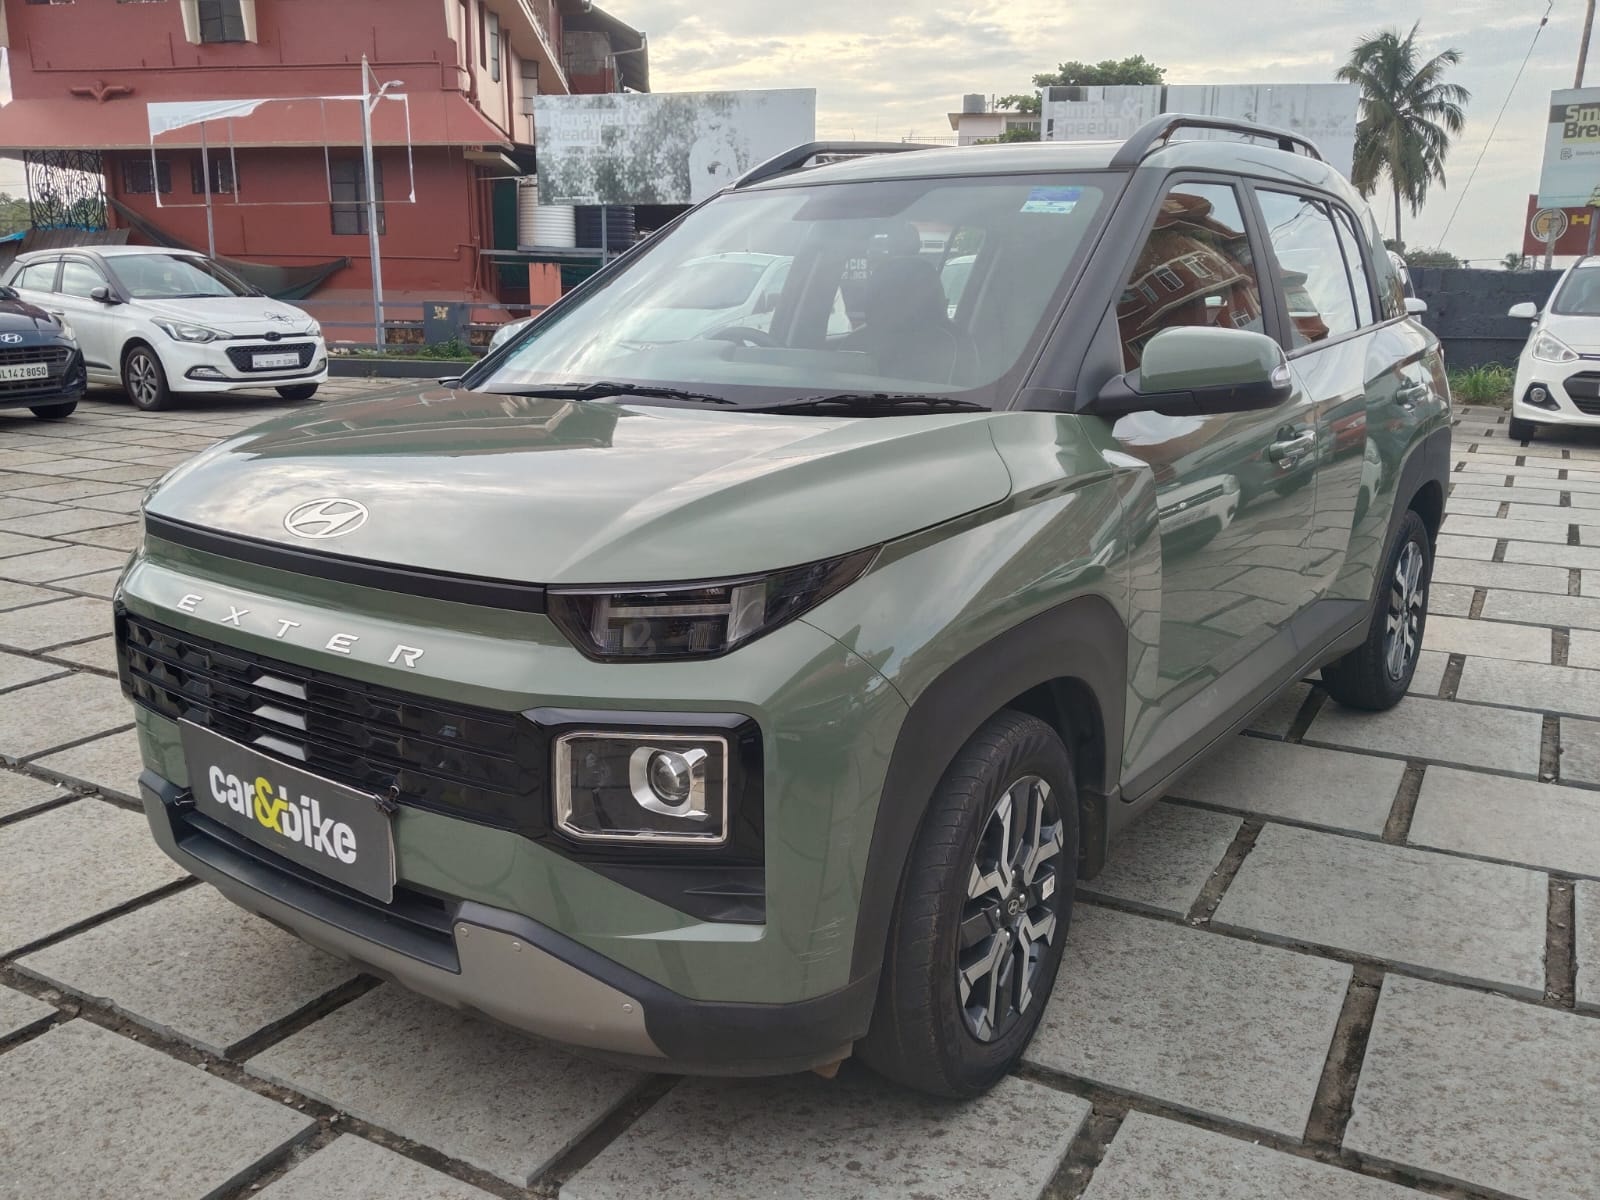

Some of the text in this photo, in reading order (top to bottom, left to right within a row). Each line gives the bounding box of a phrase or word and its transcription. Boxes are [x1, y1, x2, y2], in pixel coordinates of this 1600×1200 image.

[552, 109, 623, 125] Renewed
[1565, 105, 1600, 122] Sm
[1563, 122, 1600, 139] Bre
[177, 594, 424, 668] EXTER
[209, 765, 357, 864] car&bike
